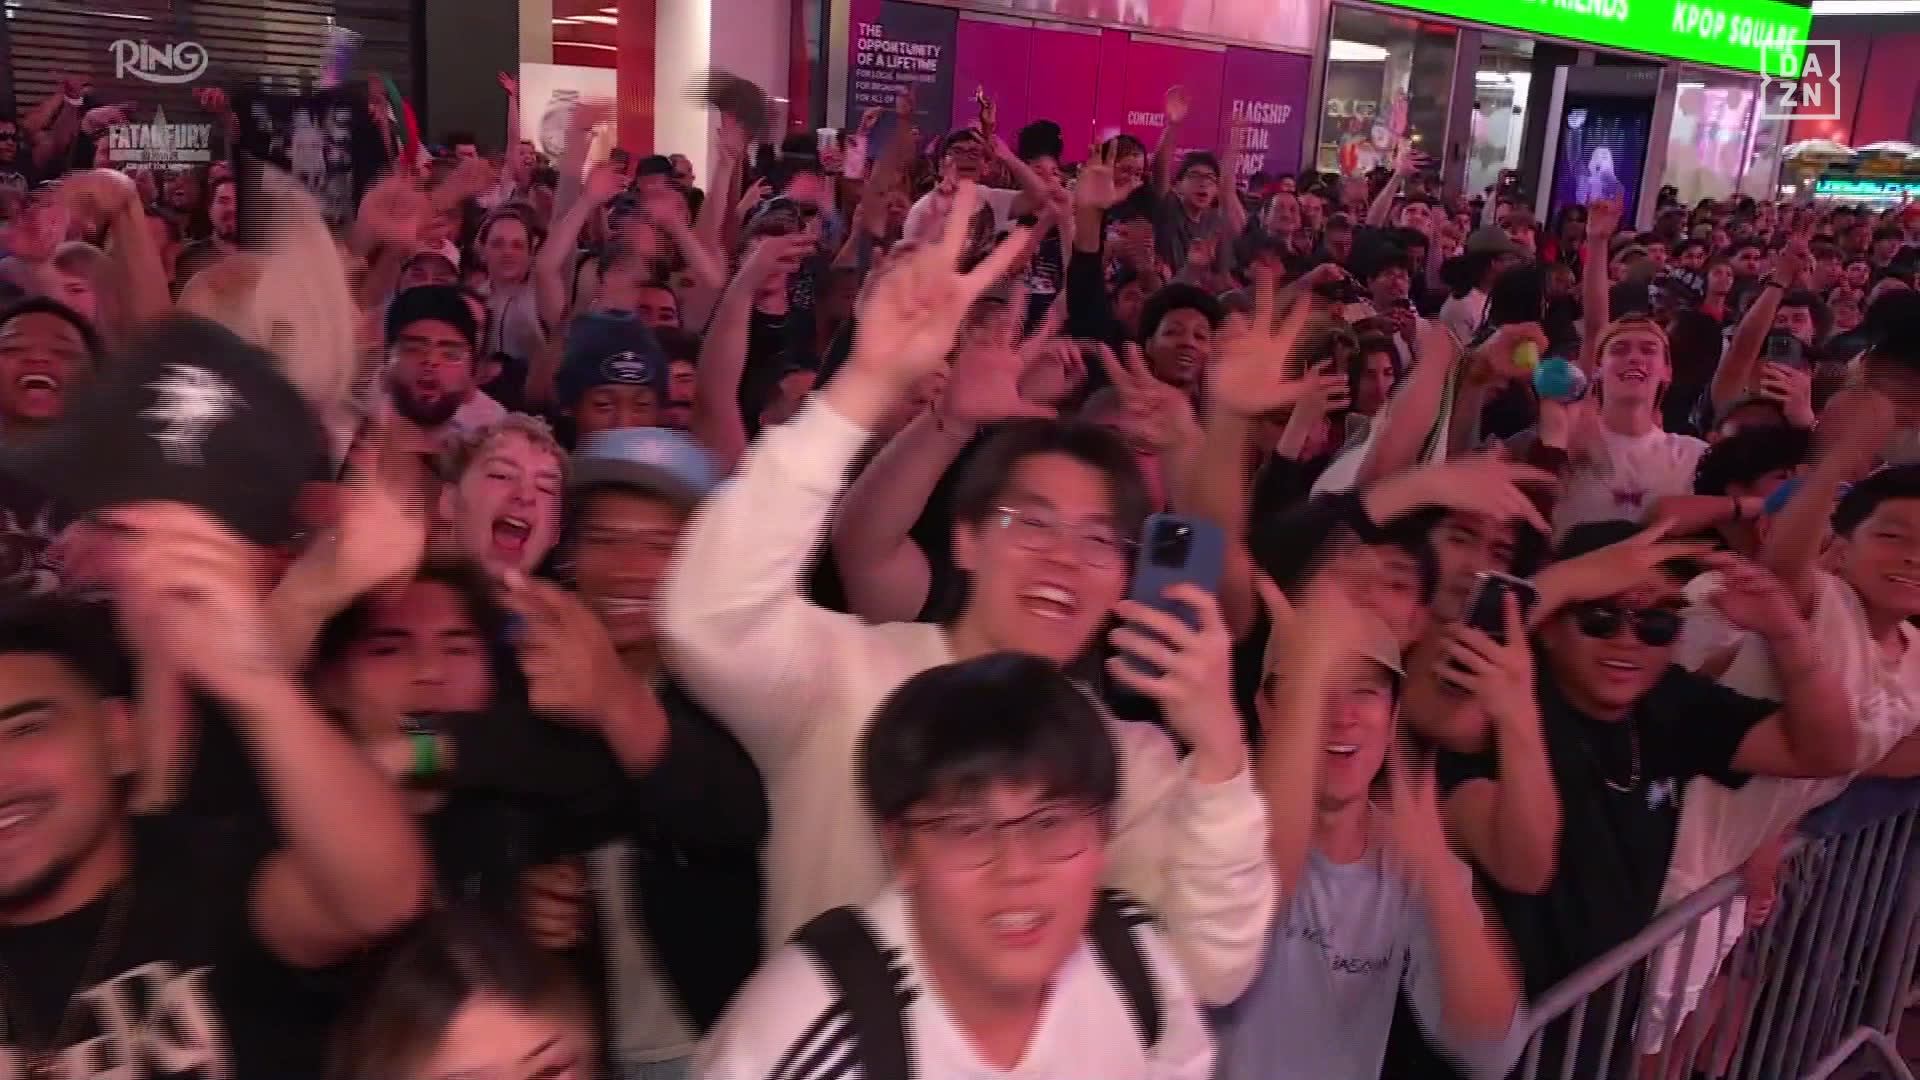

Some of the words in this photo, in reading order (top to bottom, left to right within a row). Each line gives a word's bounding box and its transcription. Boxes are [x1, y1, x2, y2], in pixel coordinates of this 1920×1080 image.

[858, 22, 883, 37] THE
[1672, 1, 1726, 40] KPOP
[1728, 15, 1799, 54] SQUARE
[858, 38, 941, 58] OPPORTUNITY
[857, 52, 874, 66] OF
[875, 53, 885, 67] A
[887, 55, 938, 72] LIFETIME
[1232, 100, 1292, 125] FLAGSHIP
